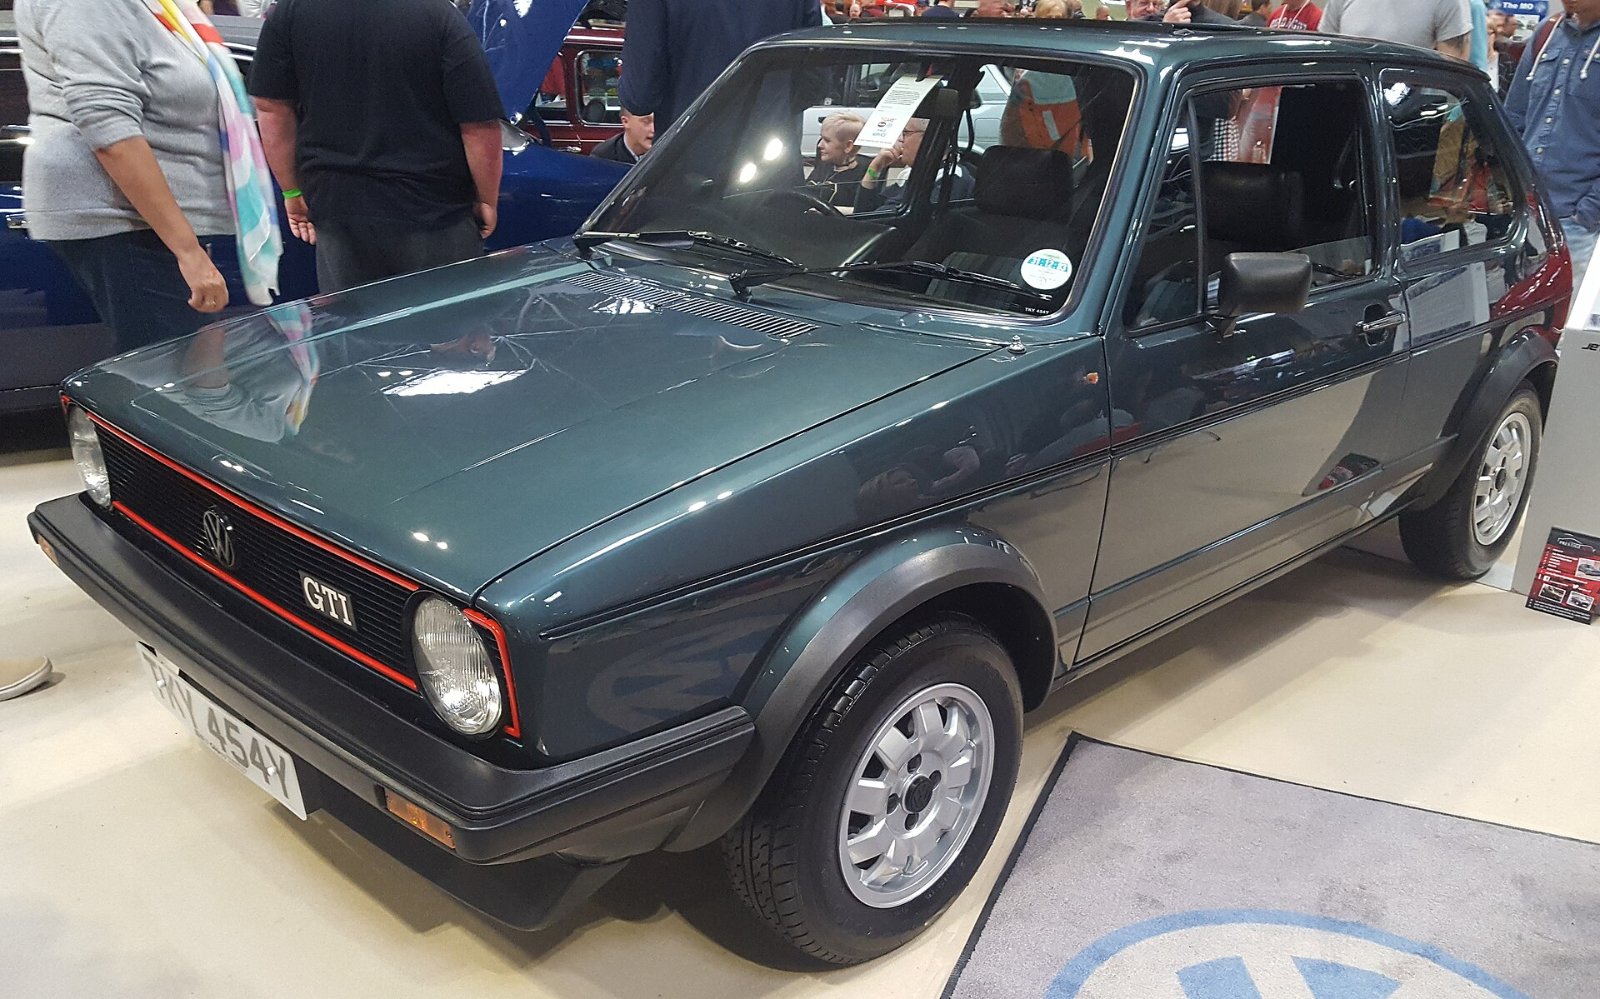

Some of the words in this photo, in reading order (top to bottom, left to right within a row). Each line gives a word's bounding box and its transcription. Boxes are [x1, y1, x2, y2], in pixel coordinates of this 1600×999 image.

[1502, 1, 1519, 9] The
[303, 576, 353, 627] GTI
[207, 706, 290, 800] 454Y
